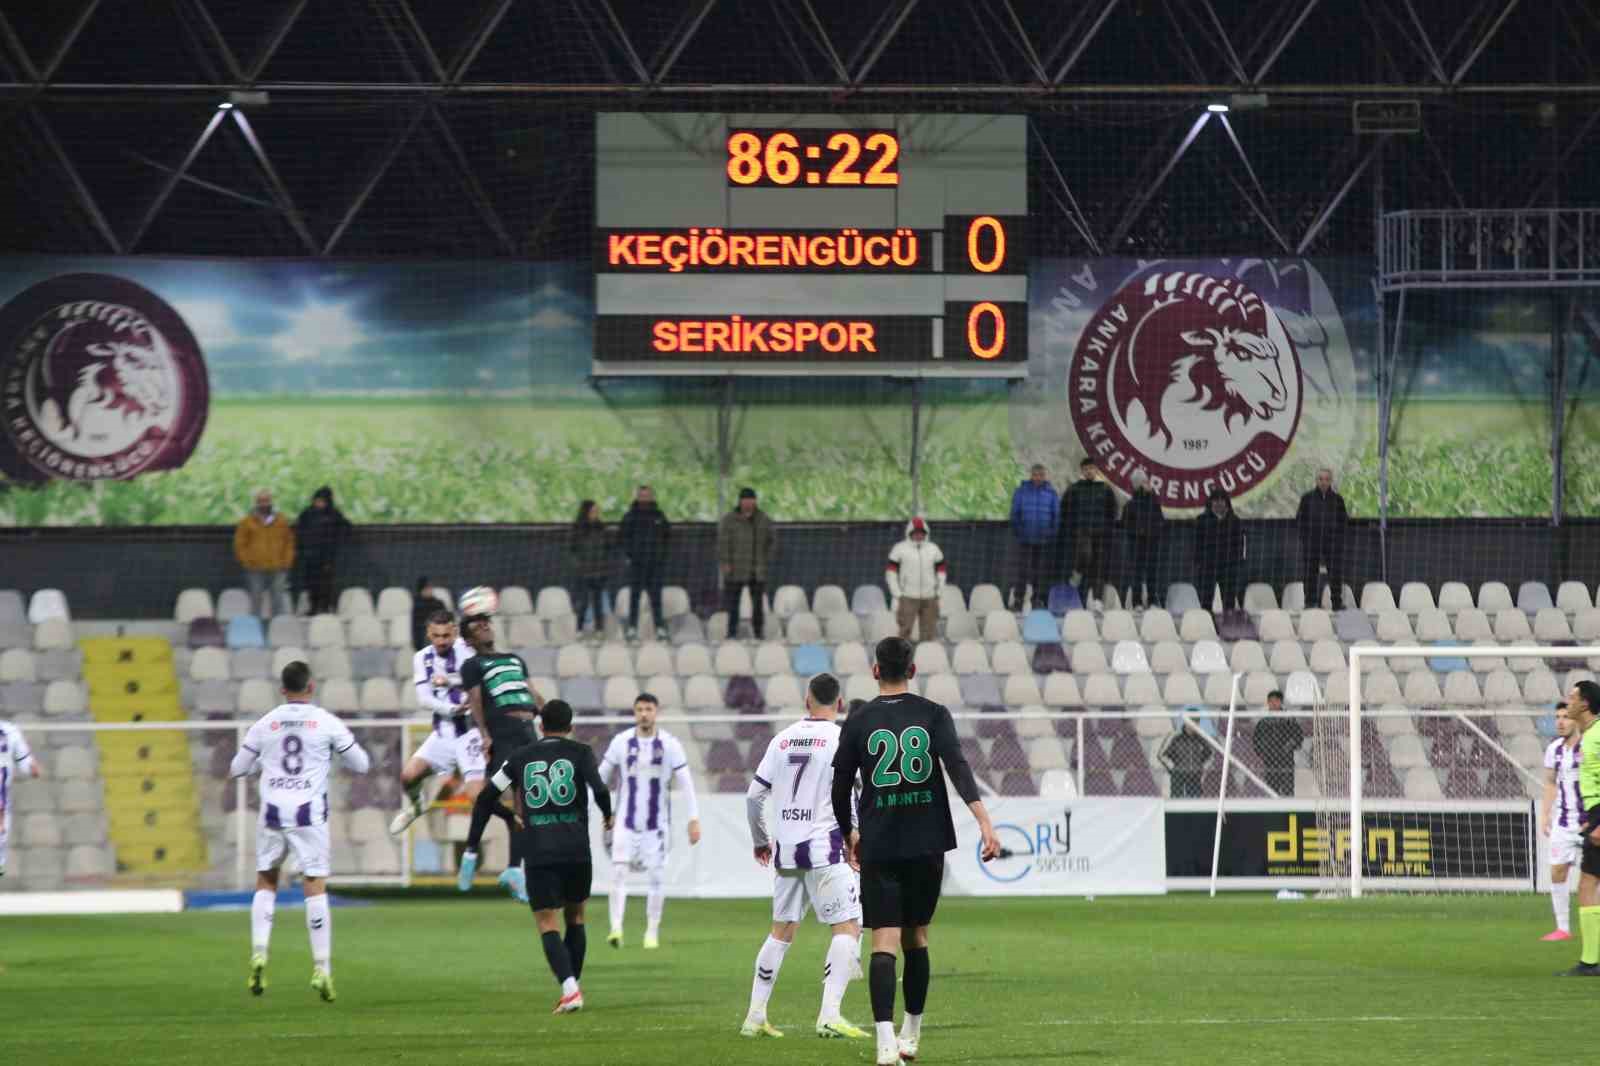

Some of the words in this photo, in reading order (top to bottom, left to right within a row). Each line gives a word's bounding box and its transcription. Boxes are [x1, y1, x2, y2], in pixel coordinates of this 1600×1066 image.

[727, 132, 899, 185] 86:22
[608, 228, 918, 272] KEÇİÖRENGÜCÜ
[967, 216, 1006, 273] 0
[652, 315, 877, 353] SERİKSPOR
[967, 302, 1006, 359] 0
[1079, 303, 1129, 414] ANKARA
[1087, 422, 1267, 500] KEÇİRENGÜCÜ
[282, 735, 303, 776] 8
[788, 738, 827, 748] POWERTEC
[868, 726, 933, 787] 28
[523, 759, 577, 809] 58
[788, 753, 812, 803] 7
